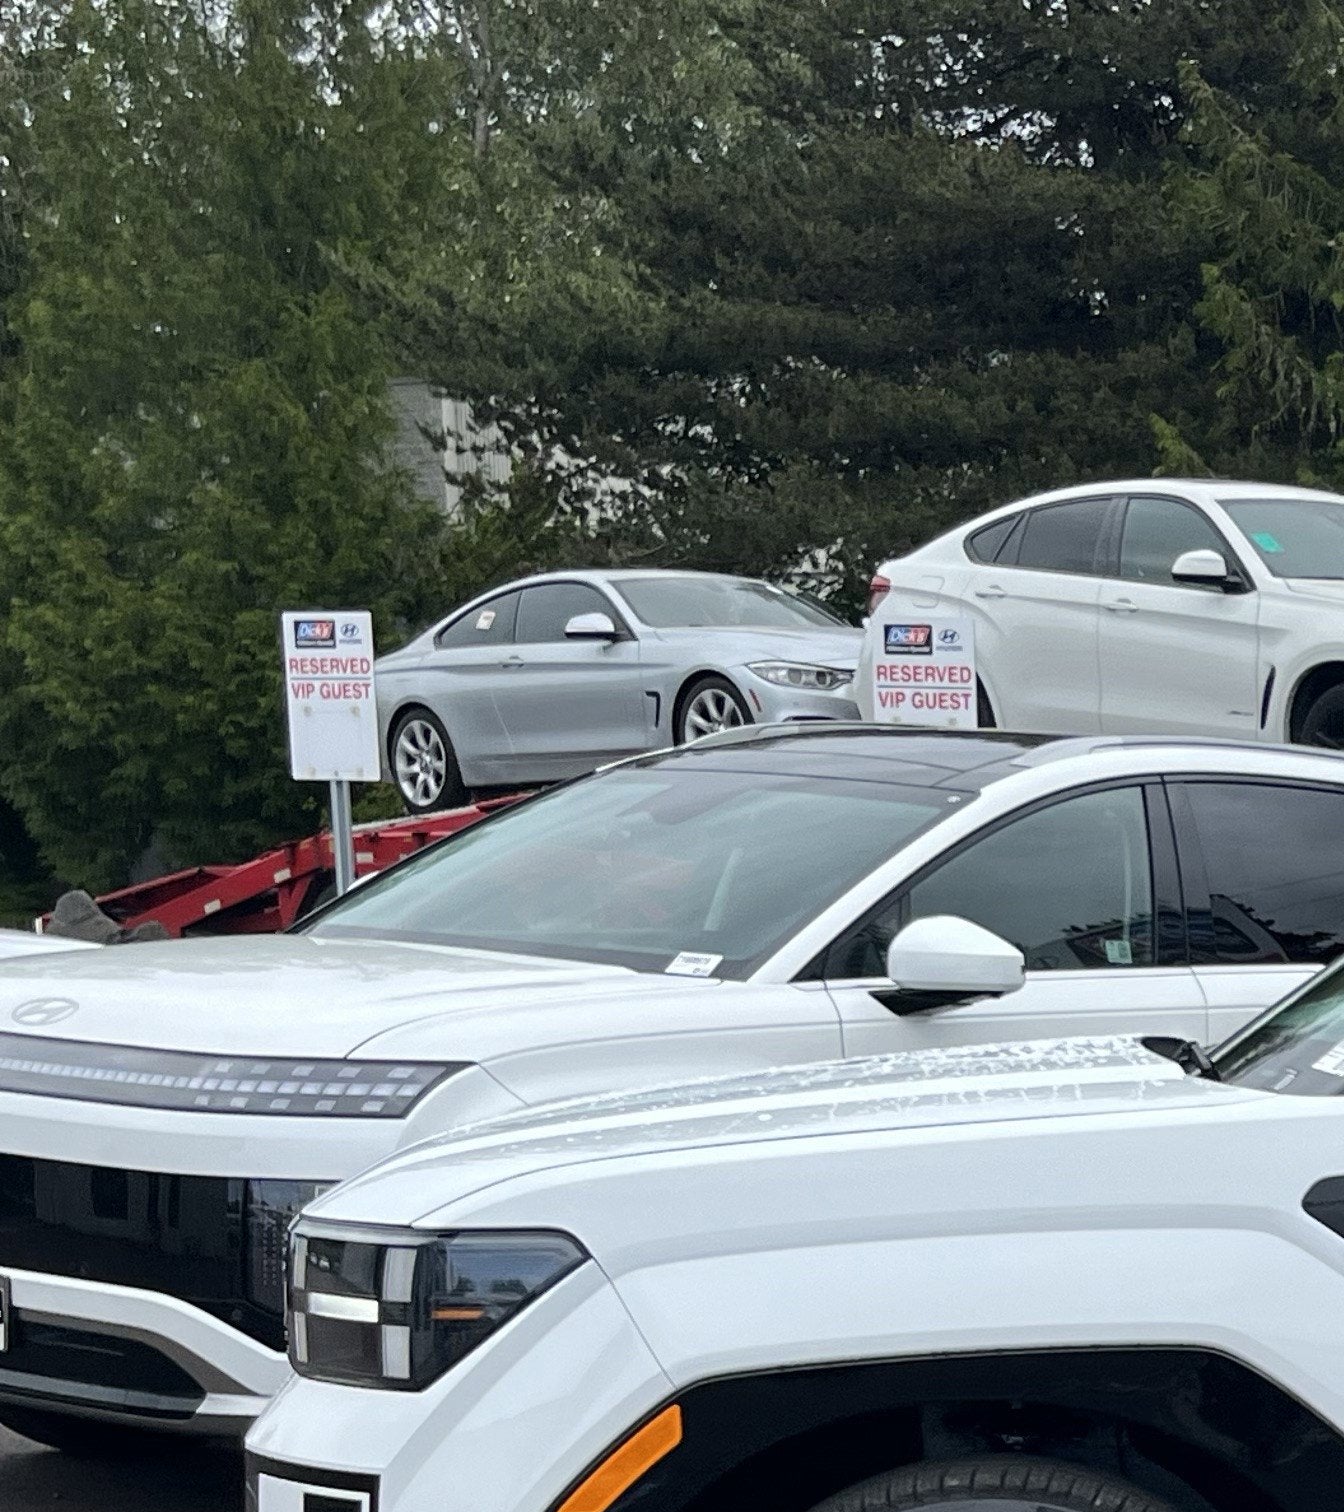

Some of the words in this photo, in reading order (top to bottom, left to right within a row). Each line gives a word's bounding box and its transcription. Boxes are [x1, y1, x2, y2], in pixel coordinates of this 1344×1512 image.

[289, 658, 370, 675] RESERVED
[876, 665, 972, 684] RESERVED
[291, 682, 315, 700] VIP
[319, 682, 371, 700] GUEST
[878, 691, 906, 709] VIP
[911, 691, 972, 711] GUEST
